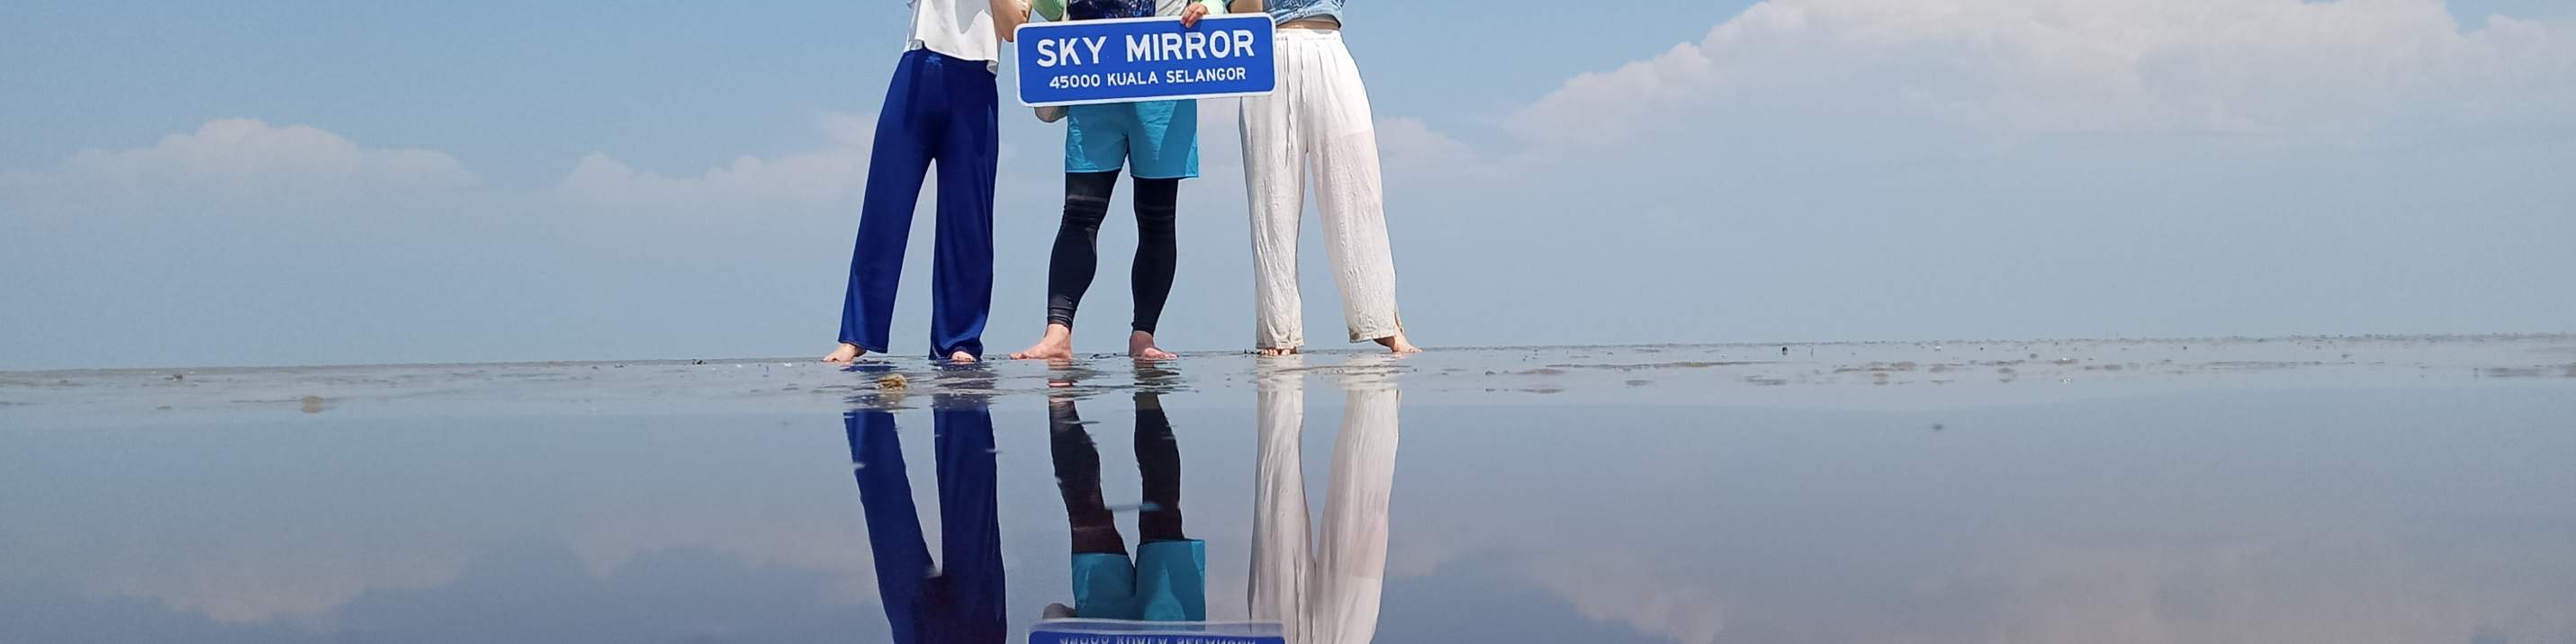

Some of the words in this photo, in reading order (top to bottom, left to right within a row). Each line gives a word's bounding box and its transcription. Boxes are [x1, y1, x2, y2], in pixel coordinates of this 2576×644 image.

[1036, 36, 1107, 67] SKY
[1125, 29, 1255, 62] MIRROR
[1049, 74, 1101, 89] 45000
[1107, 71, 1158, 86] KUALA
[1166, 67, 1246, 84] SELANGOR
